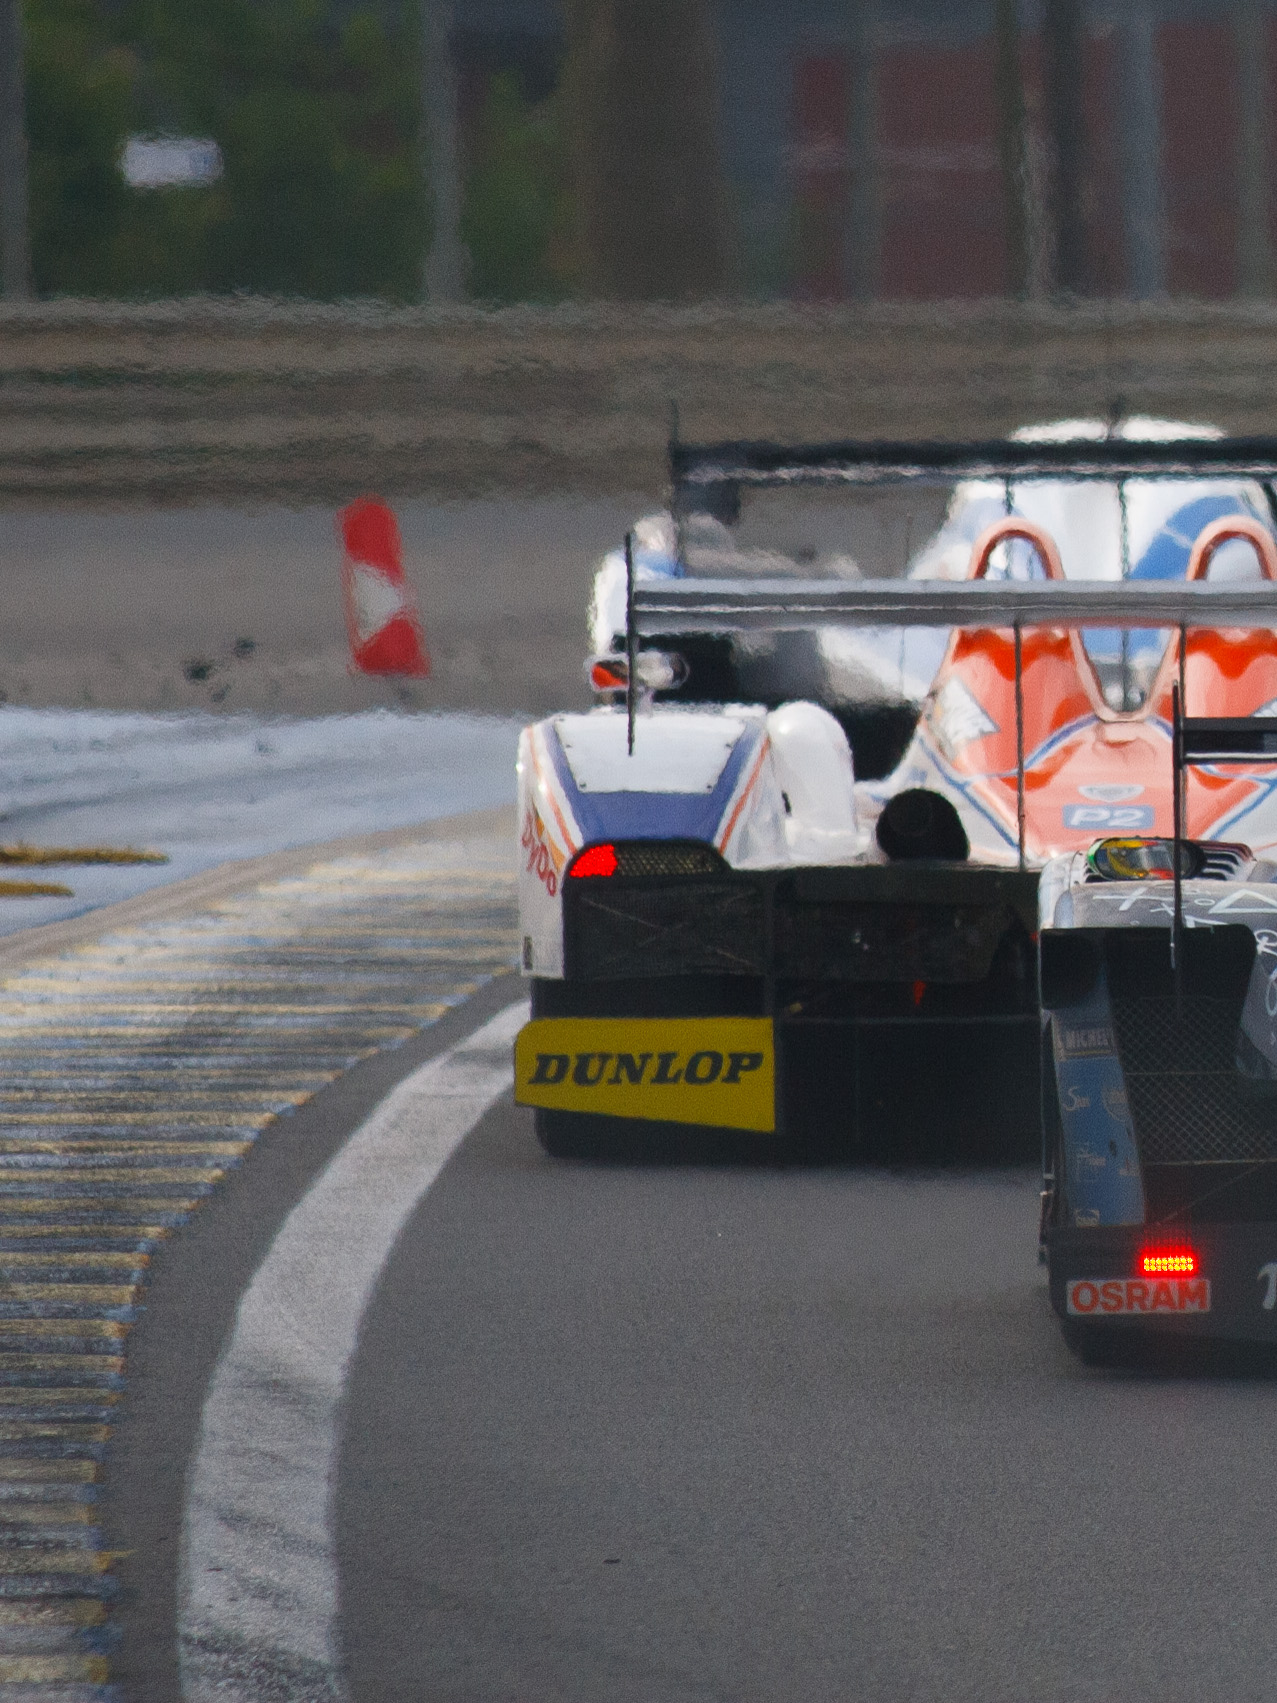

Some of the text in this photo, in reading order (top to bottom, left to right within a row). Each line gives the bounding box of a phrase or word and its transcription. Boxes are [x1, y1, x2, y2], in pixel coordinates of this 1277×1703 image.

[1069, 808, 1146, 828] P2
[527, 1051, 764, 1087] DUNLOP
[1072, 1280, 1209, 1313] OSRAM
